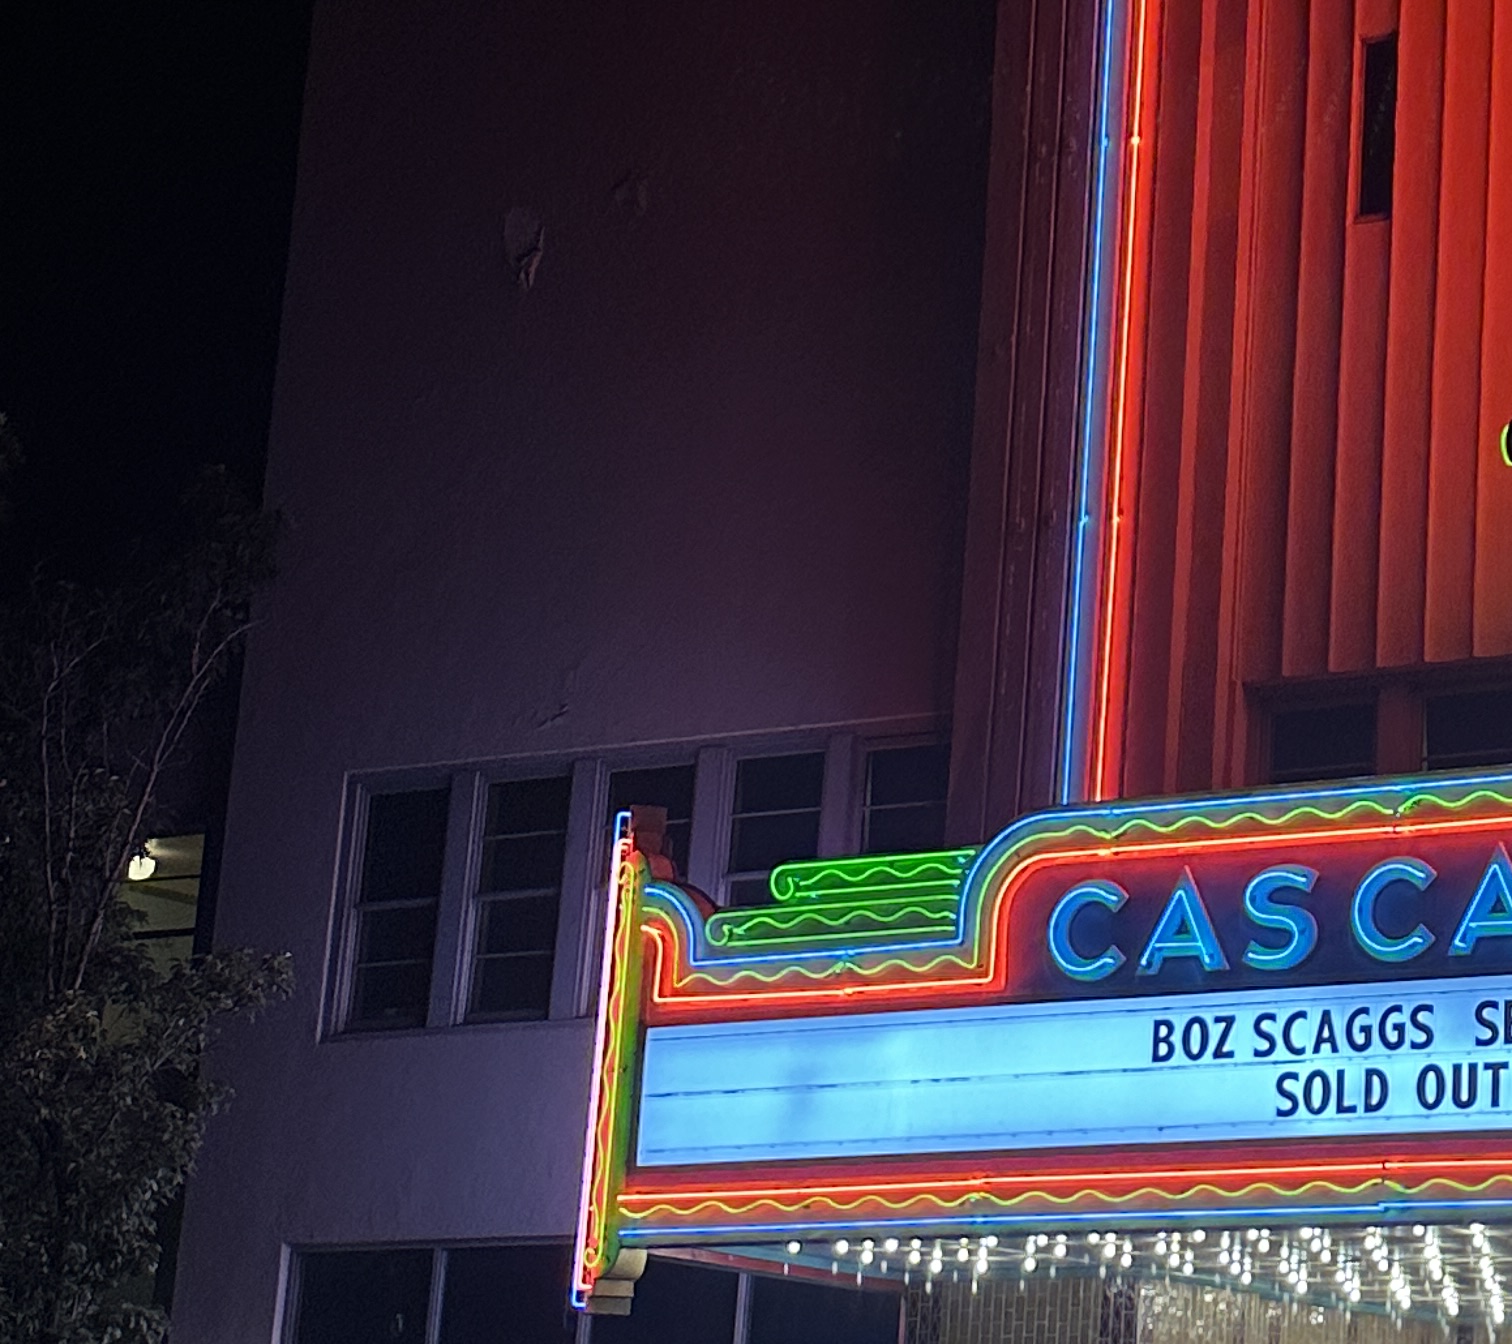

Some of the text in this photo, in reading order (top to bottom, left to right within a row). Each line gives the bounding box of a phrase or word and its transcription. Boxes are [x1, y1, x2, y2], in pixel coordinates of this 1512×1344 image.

[1152, 1015, 1235, 1063] BOZ
[1253, 1003, 1435, 1058] SCAGGS
[1275, 1062, 1509, 1118] SOLD OUT
